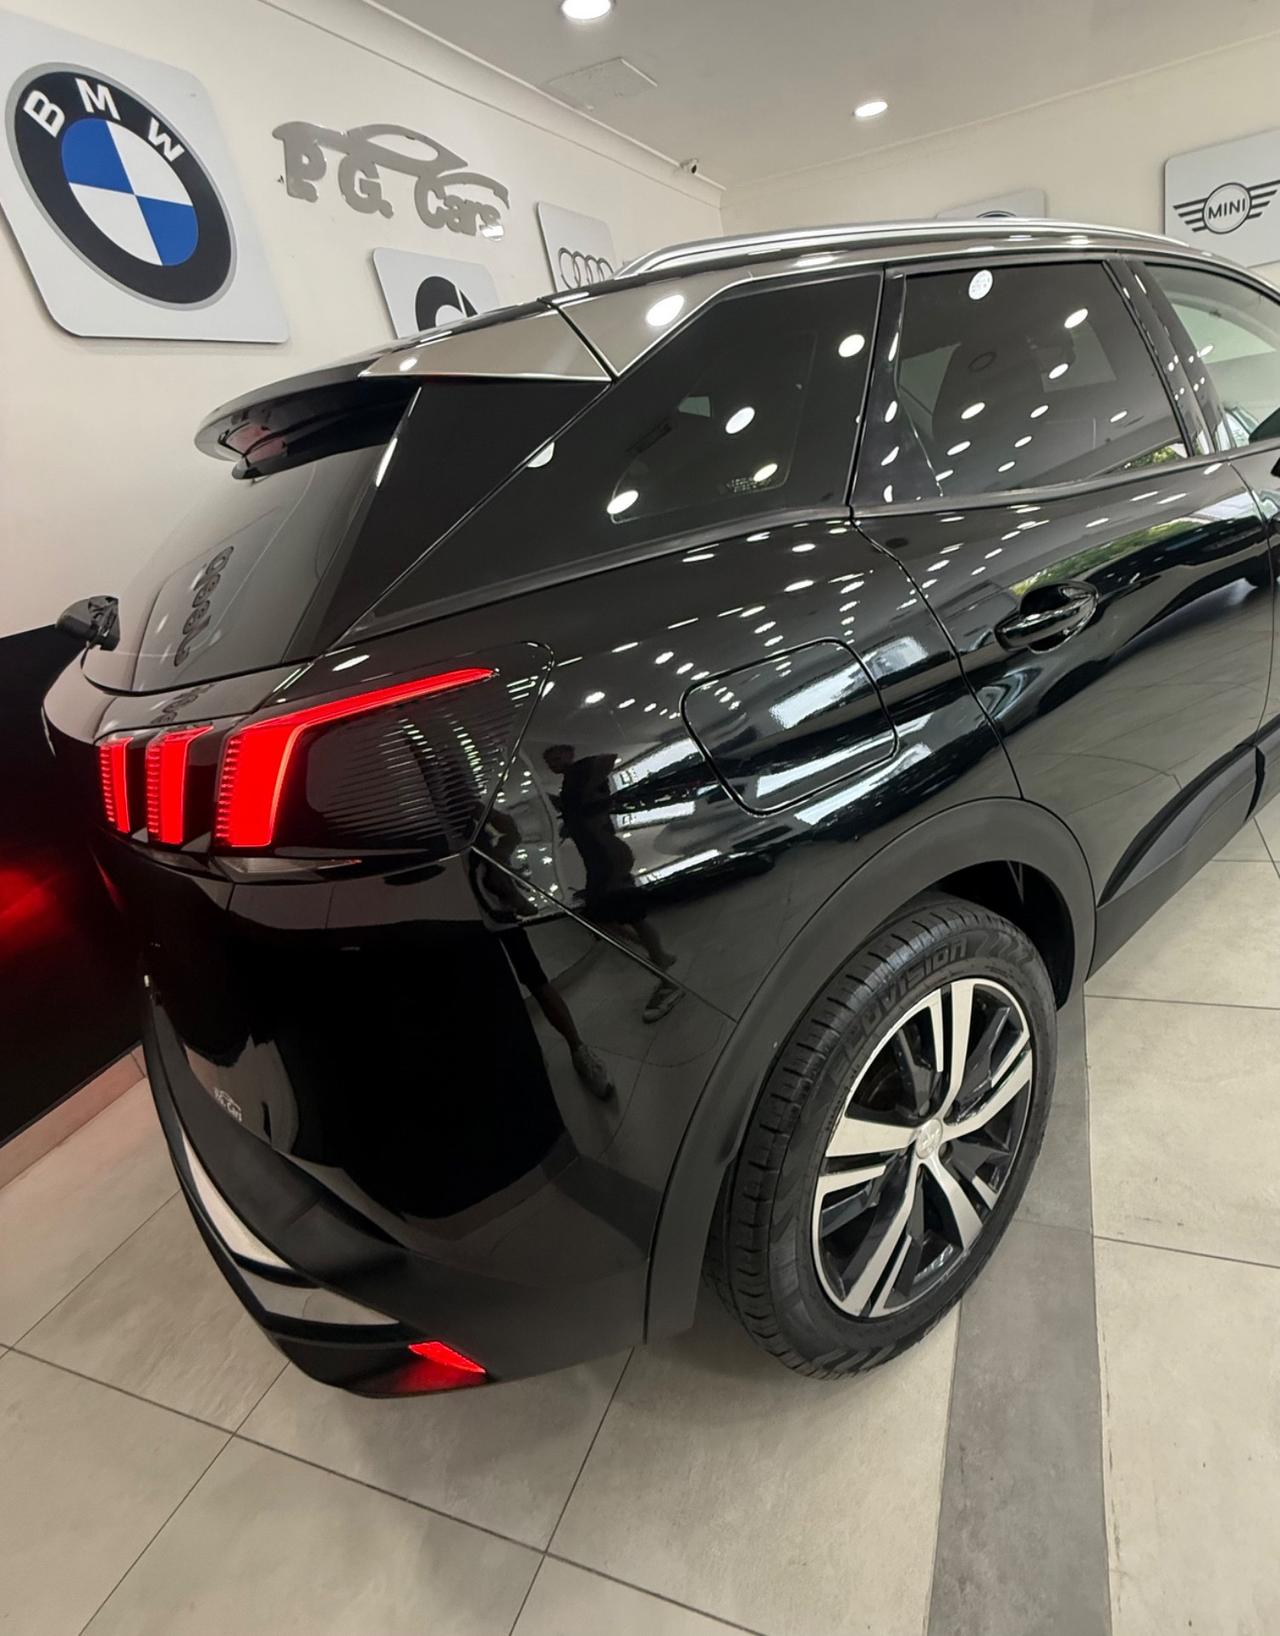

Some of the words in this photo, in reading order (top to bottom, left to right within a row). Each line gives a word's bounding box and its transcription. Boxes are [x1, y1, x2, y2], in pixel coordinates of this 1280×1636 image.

[23, 77, 185, 162] BMW
[414, 176, 507, 241] Cars
[1208, 198, 1246, 219] MINI
